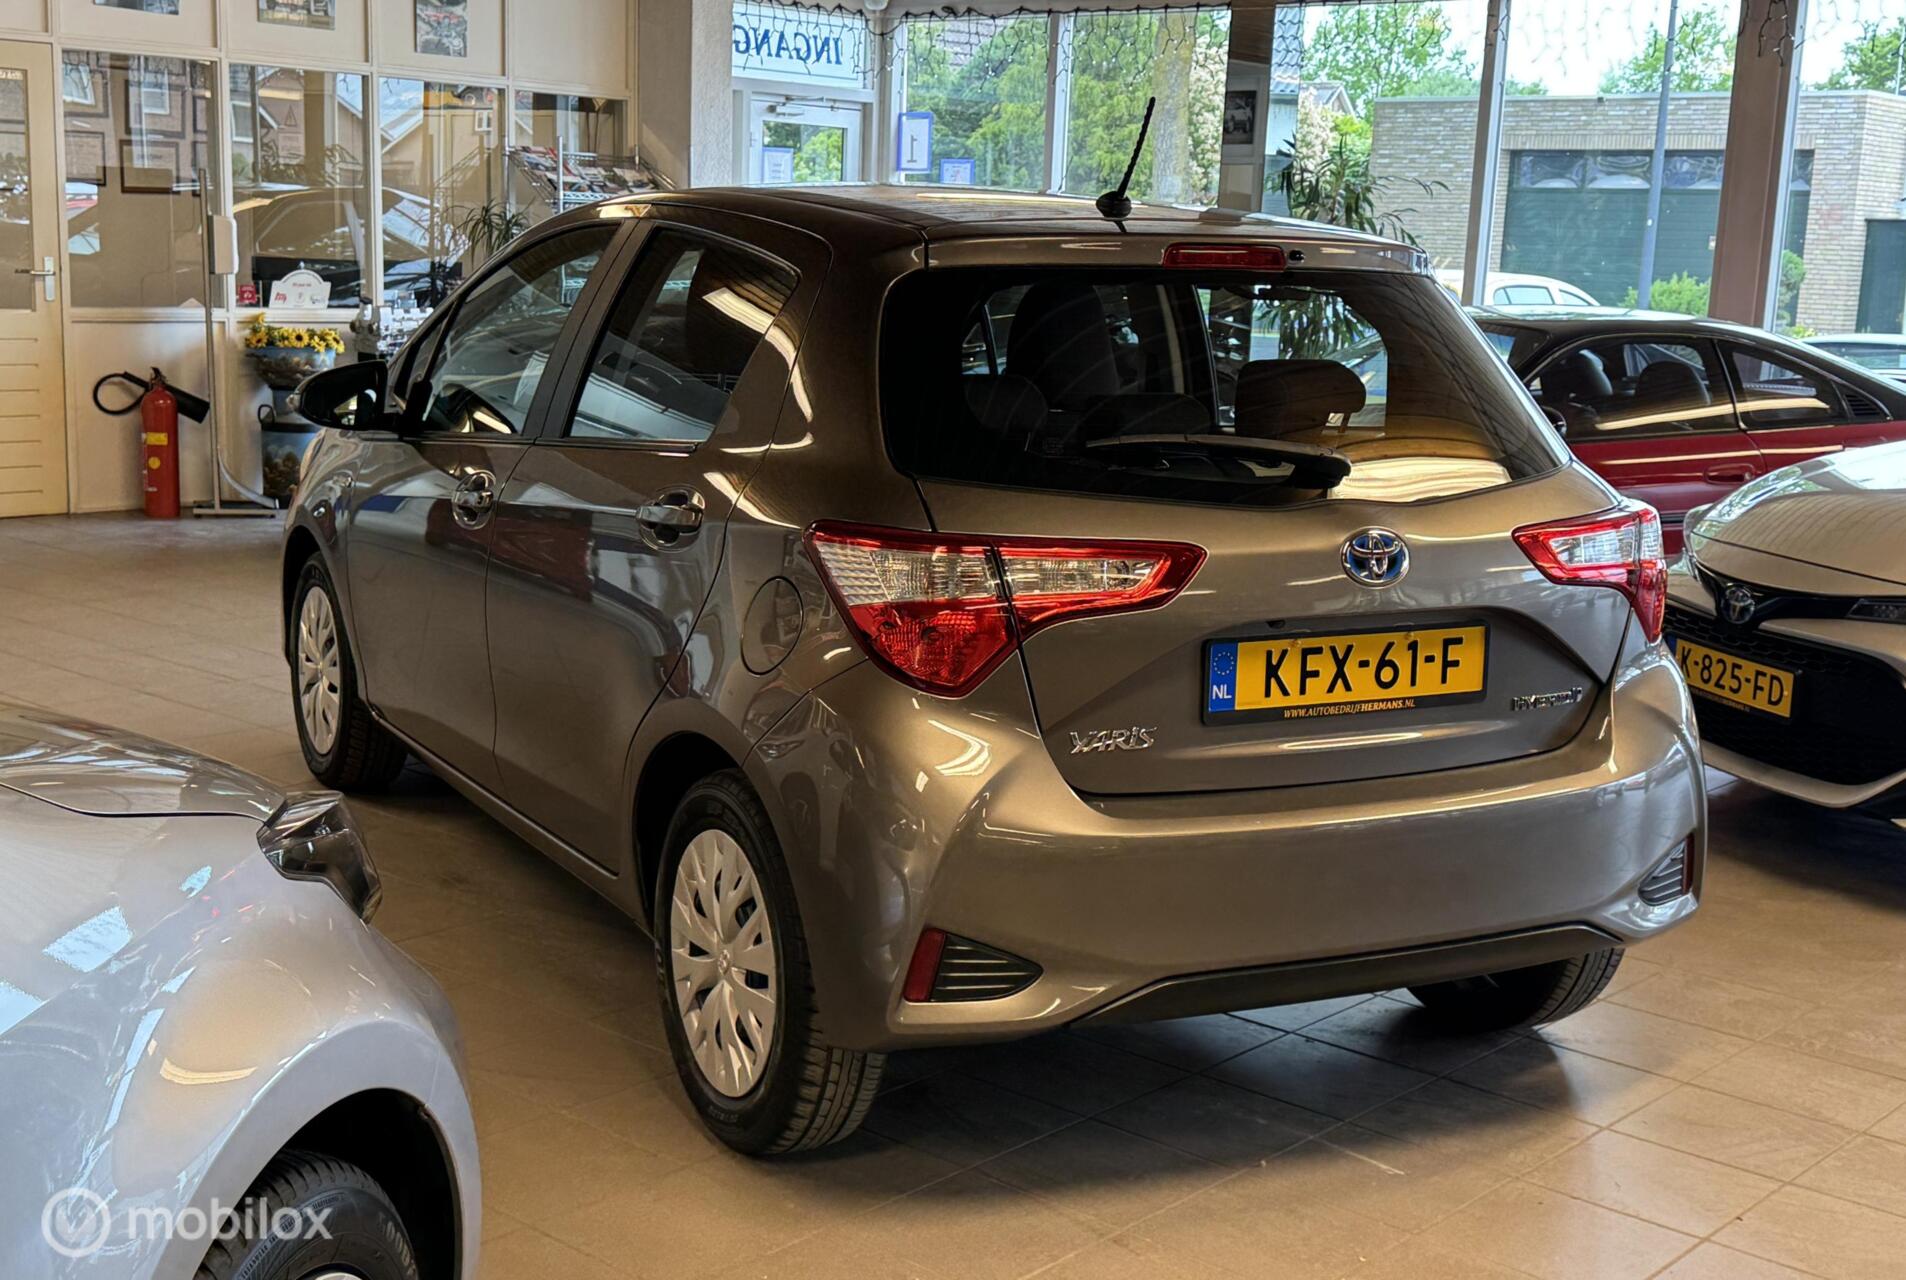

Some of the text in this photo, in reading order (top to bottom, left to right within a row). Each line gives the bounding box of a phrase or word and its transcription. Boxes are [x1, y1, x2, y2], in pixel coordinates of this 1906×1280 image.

[1264, 636, 1464, 698] KFX-61-F
[1681, 646, 1785, 706] K-825-FD
[1212, 684, 1233, 699] NL
[1283, 698, 1416, 718] WWW.AUTOBEDRIJFHERMANS.NL
